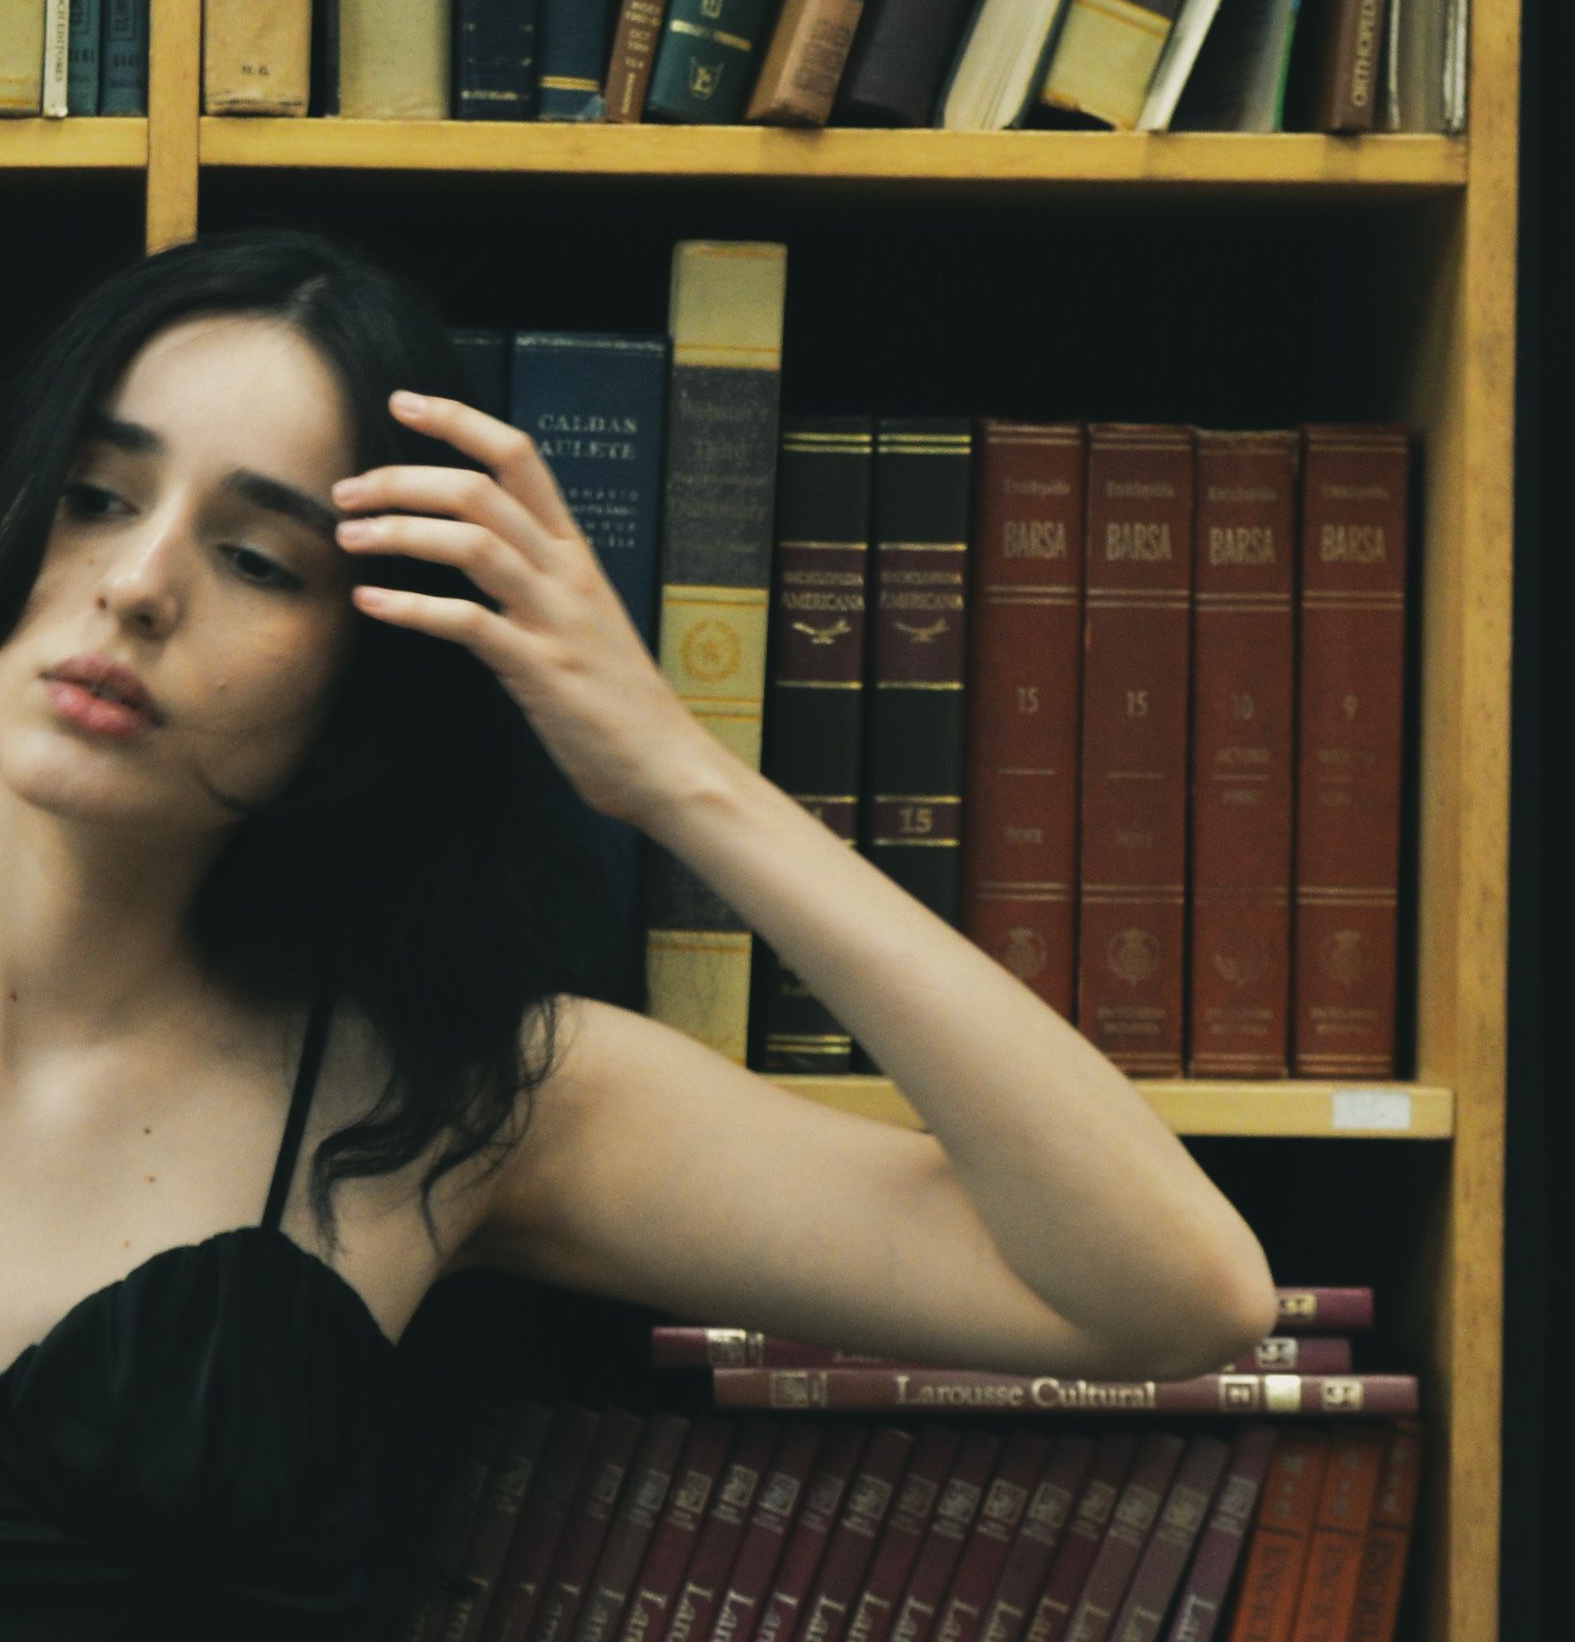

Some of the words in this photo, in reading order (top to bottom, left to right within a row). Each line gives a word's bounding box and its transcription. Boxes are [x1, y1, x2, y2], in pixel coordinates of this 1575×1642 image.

[537, 413, 639, 434] CALDAS
[539, 439, 637, 459] AULETE
[1106, 522, 1171, 561] BARSA
[1209, 526, 1275, 565] BARSA
[1320, 525, 1386, 563] BARSA
[1126, 691, 1148, 717] 15
[1343, 694, 1357, 720] 9
[898, 808, 933, 833] 15
[895, 1376, 1024, 1410] Larousse
[1031, 1378, 1155, 1411] Cultural
